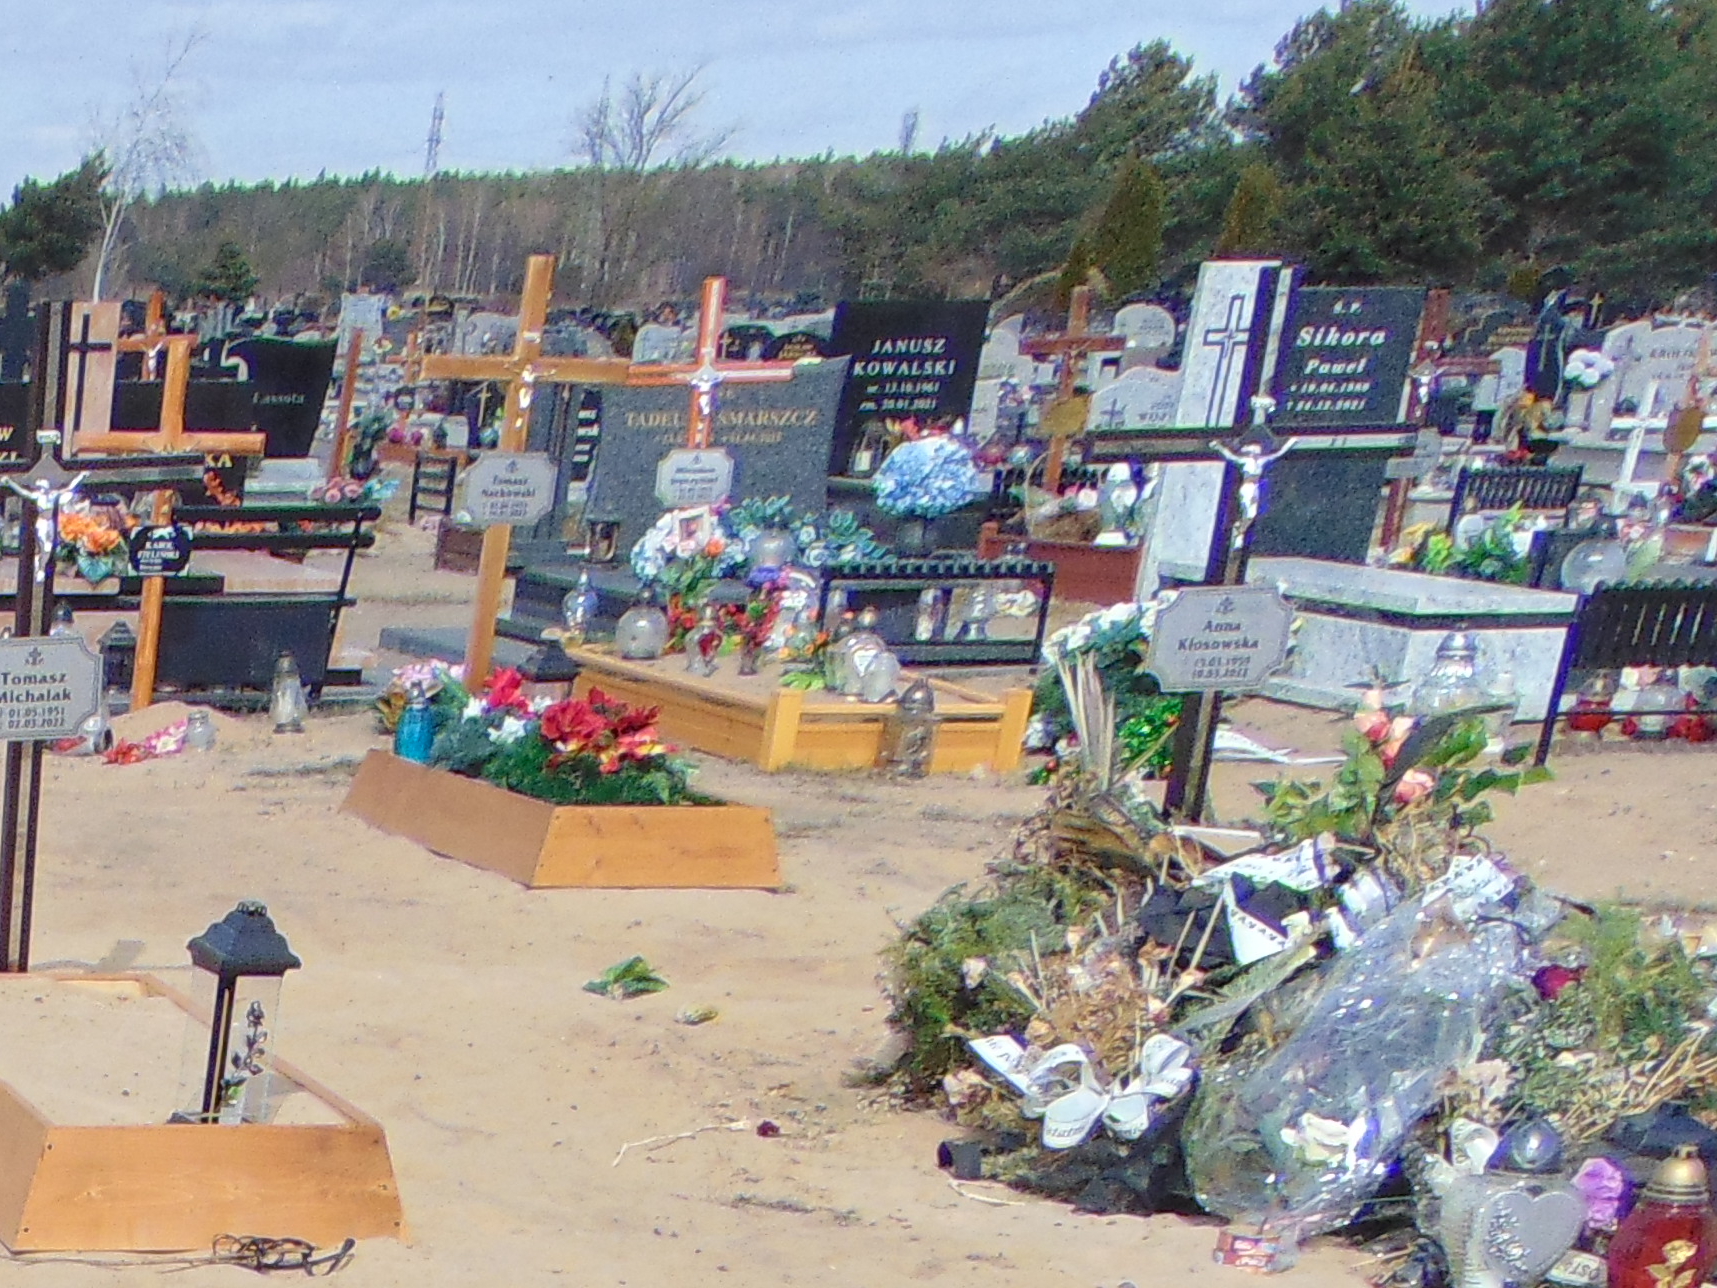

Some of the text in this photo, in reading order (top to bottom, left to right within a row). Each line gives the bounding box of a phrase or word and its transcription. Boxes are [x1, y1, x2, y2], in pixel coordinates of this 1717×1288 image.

[1296, 327, 1387, 347] Sikora
[871, 338, 947, 354] JANUSZ
[853, 361, 956, 376] KOWALSKI
[1203, 620, 1241, 633] Anna
[1, 672, 66, 686] Tomasz
